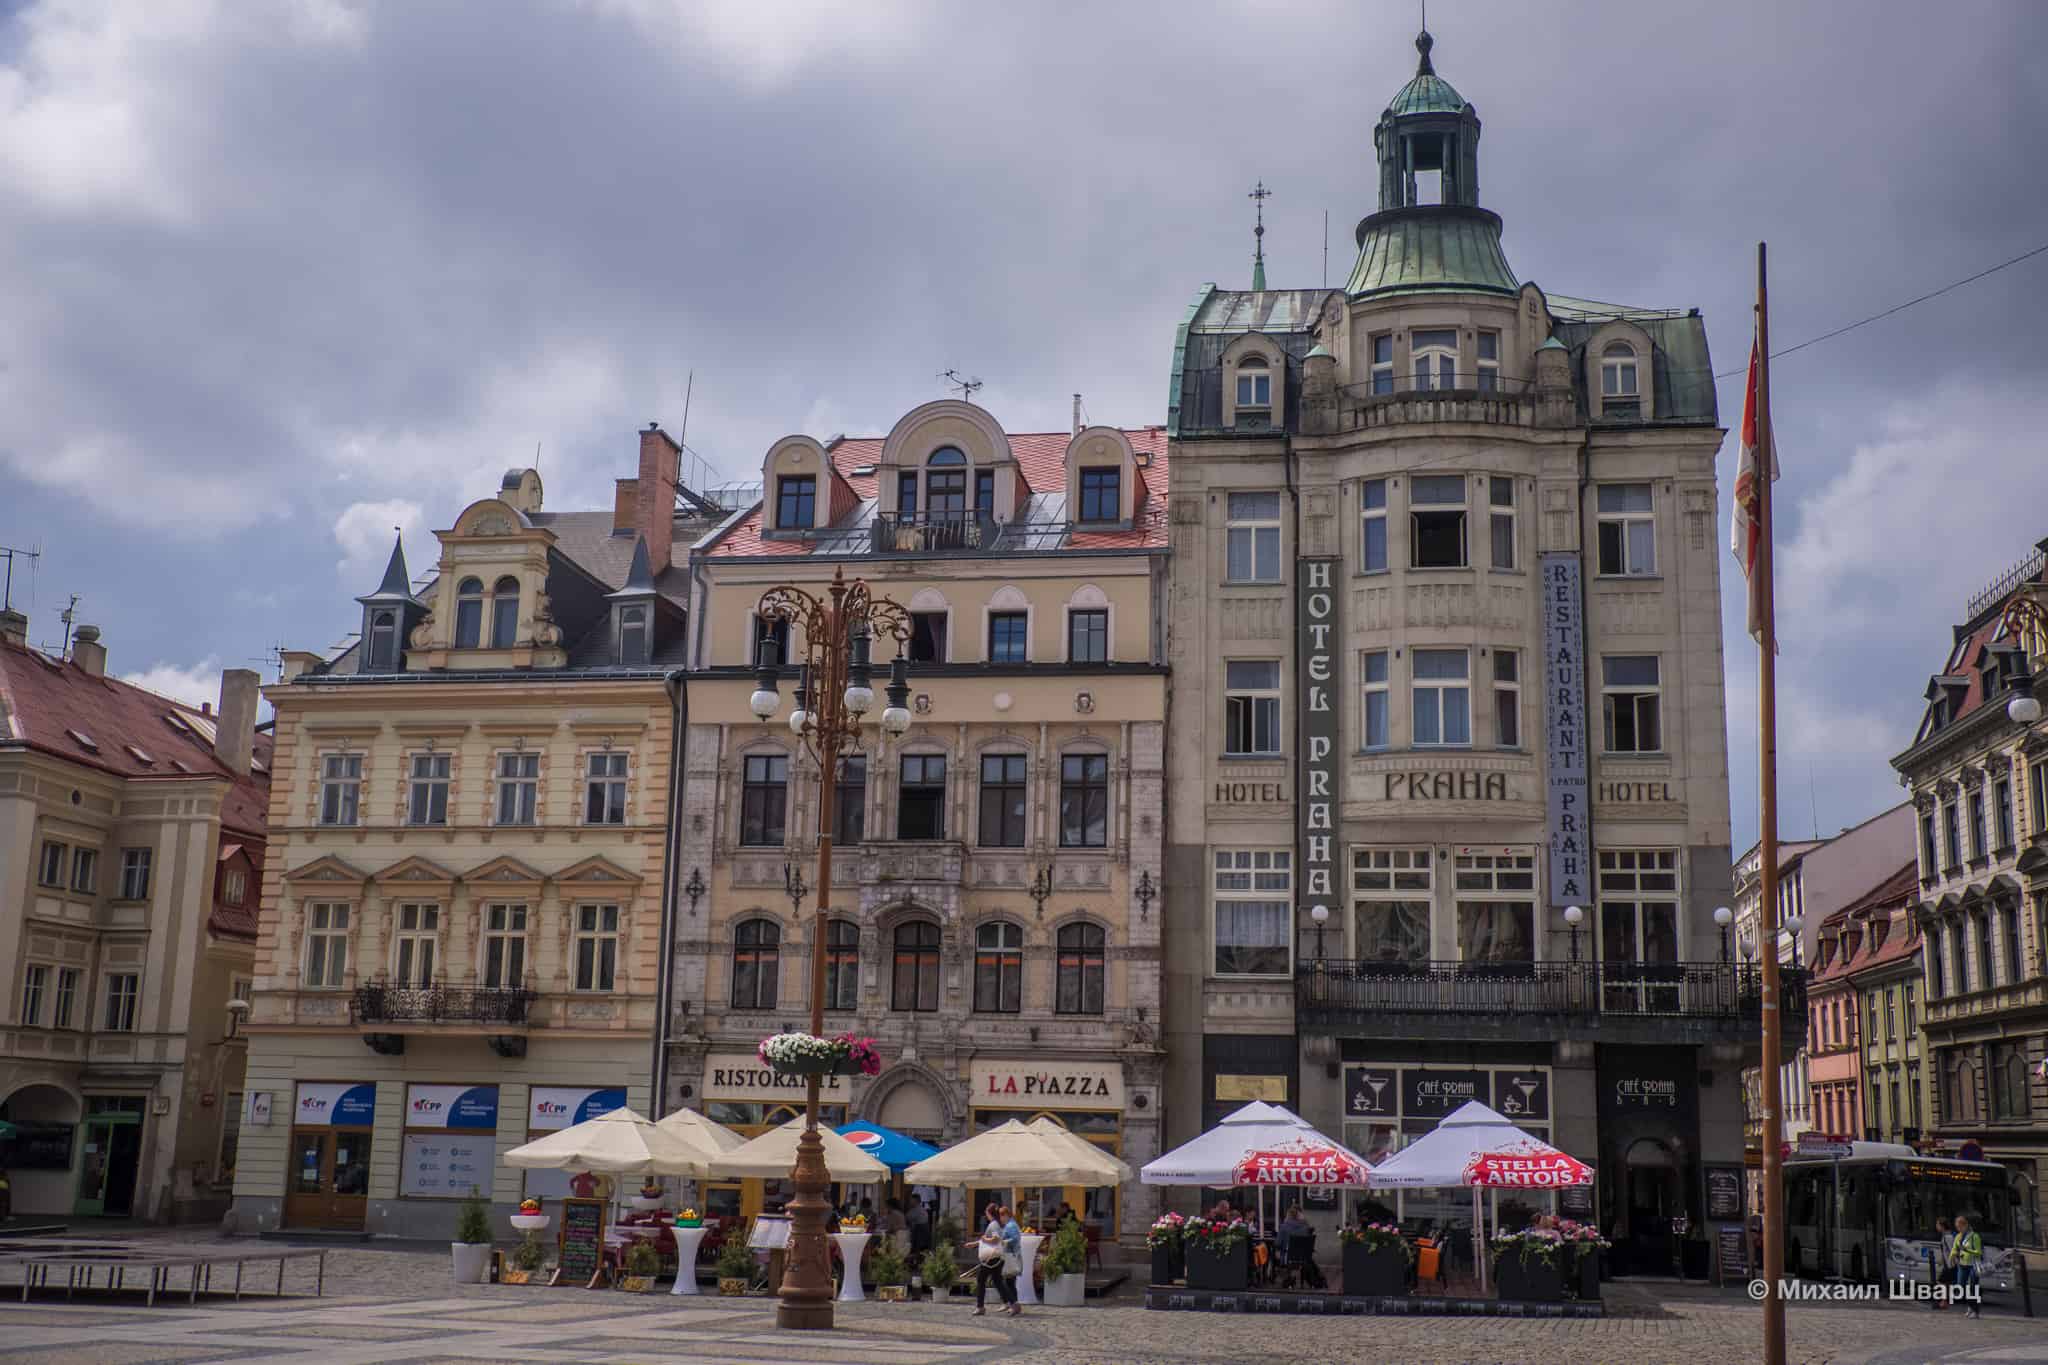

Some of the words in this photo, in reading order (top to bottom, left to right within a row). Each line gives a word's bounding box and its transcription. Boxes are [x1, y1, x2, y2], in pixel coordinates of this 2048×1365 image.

[1308, 562, 1331, 711] HOTEL
[1553, 565, 1576, 768] RESTAURANT
[1216, 783, 1288, 802] HOTEL
[1385, 772, 1507, 801] PRAHA
[1599, 783, 1677, 801] HOTEL
[1307, 736, 1331, 895] PRAHA
[1562, 793, 1580, 896] PRAHA
[988, 1075, 1019, 1094] LA
[1256, 1157, 1337, 1167] STELLA
[1486, 1159, 1571, 1170] STELLA
[1256, 1167, 1339, 1184] ARTOIS
[1487, 1170, 1574, 1185] ARTOIS
